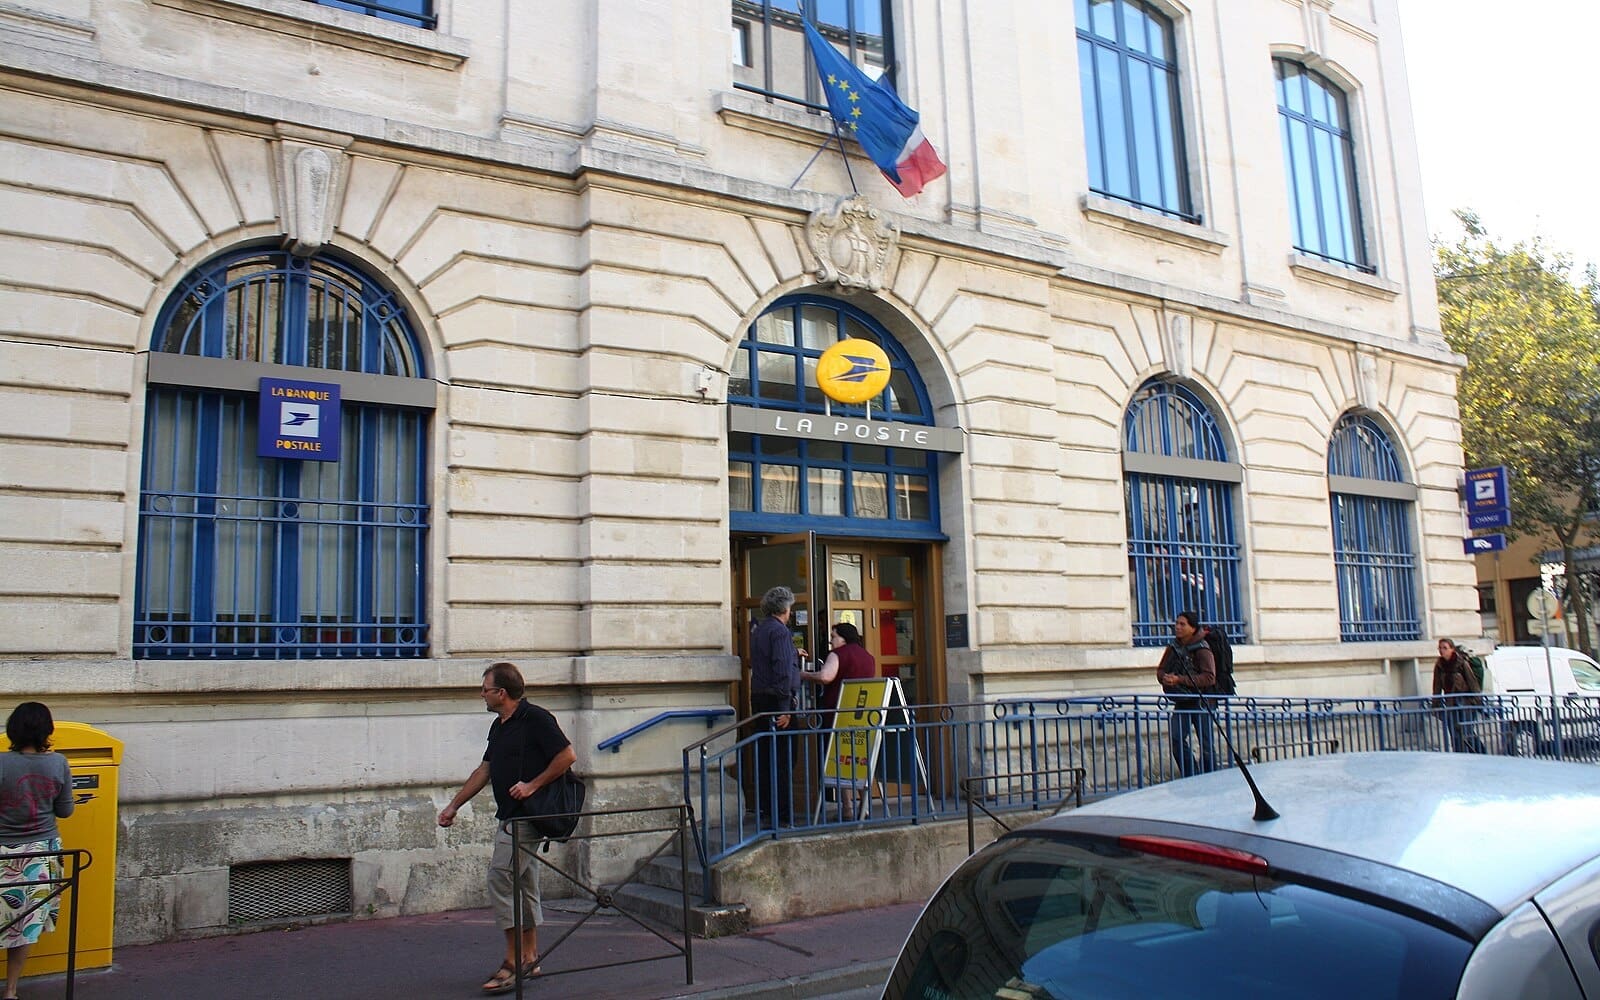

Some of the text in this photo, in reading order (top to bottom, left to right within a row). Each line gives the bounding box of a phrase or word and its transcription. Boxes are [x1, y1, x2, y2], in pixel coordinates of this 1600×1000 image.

[272, 387, 330, 400] LA BANQUE
[775, 416, 929, 444] LA POSTE
[276, 440, 321, 451] POSTALE
